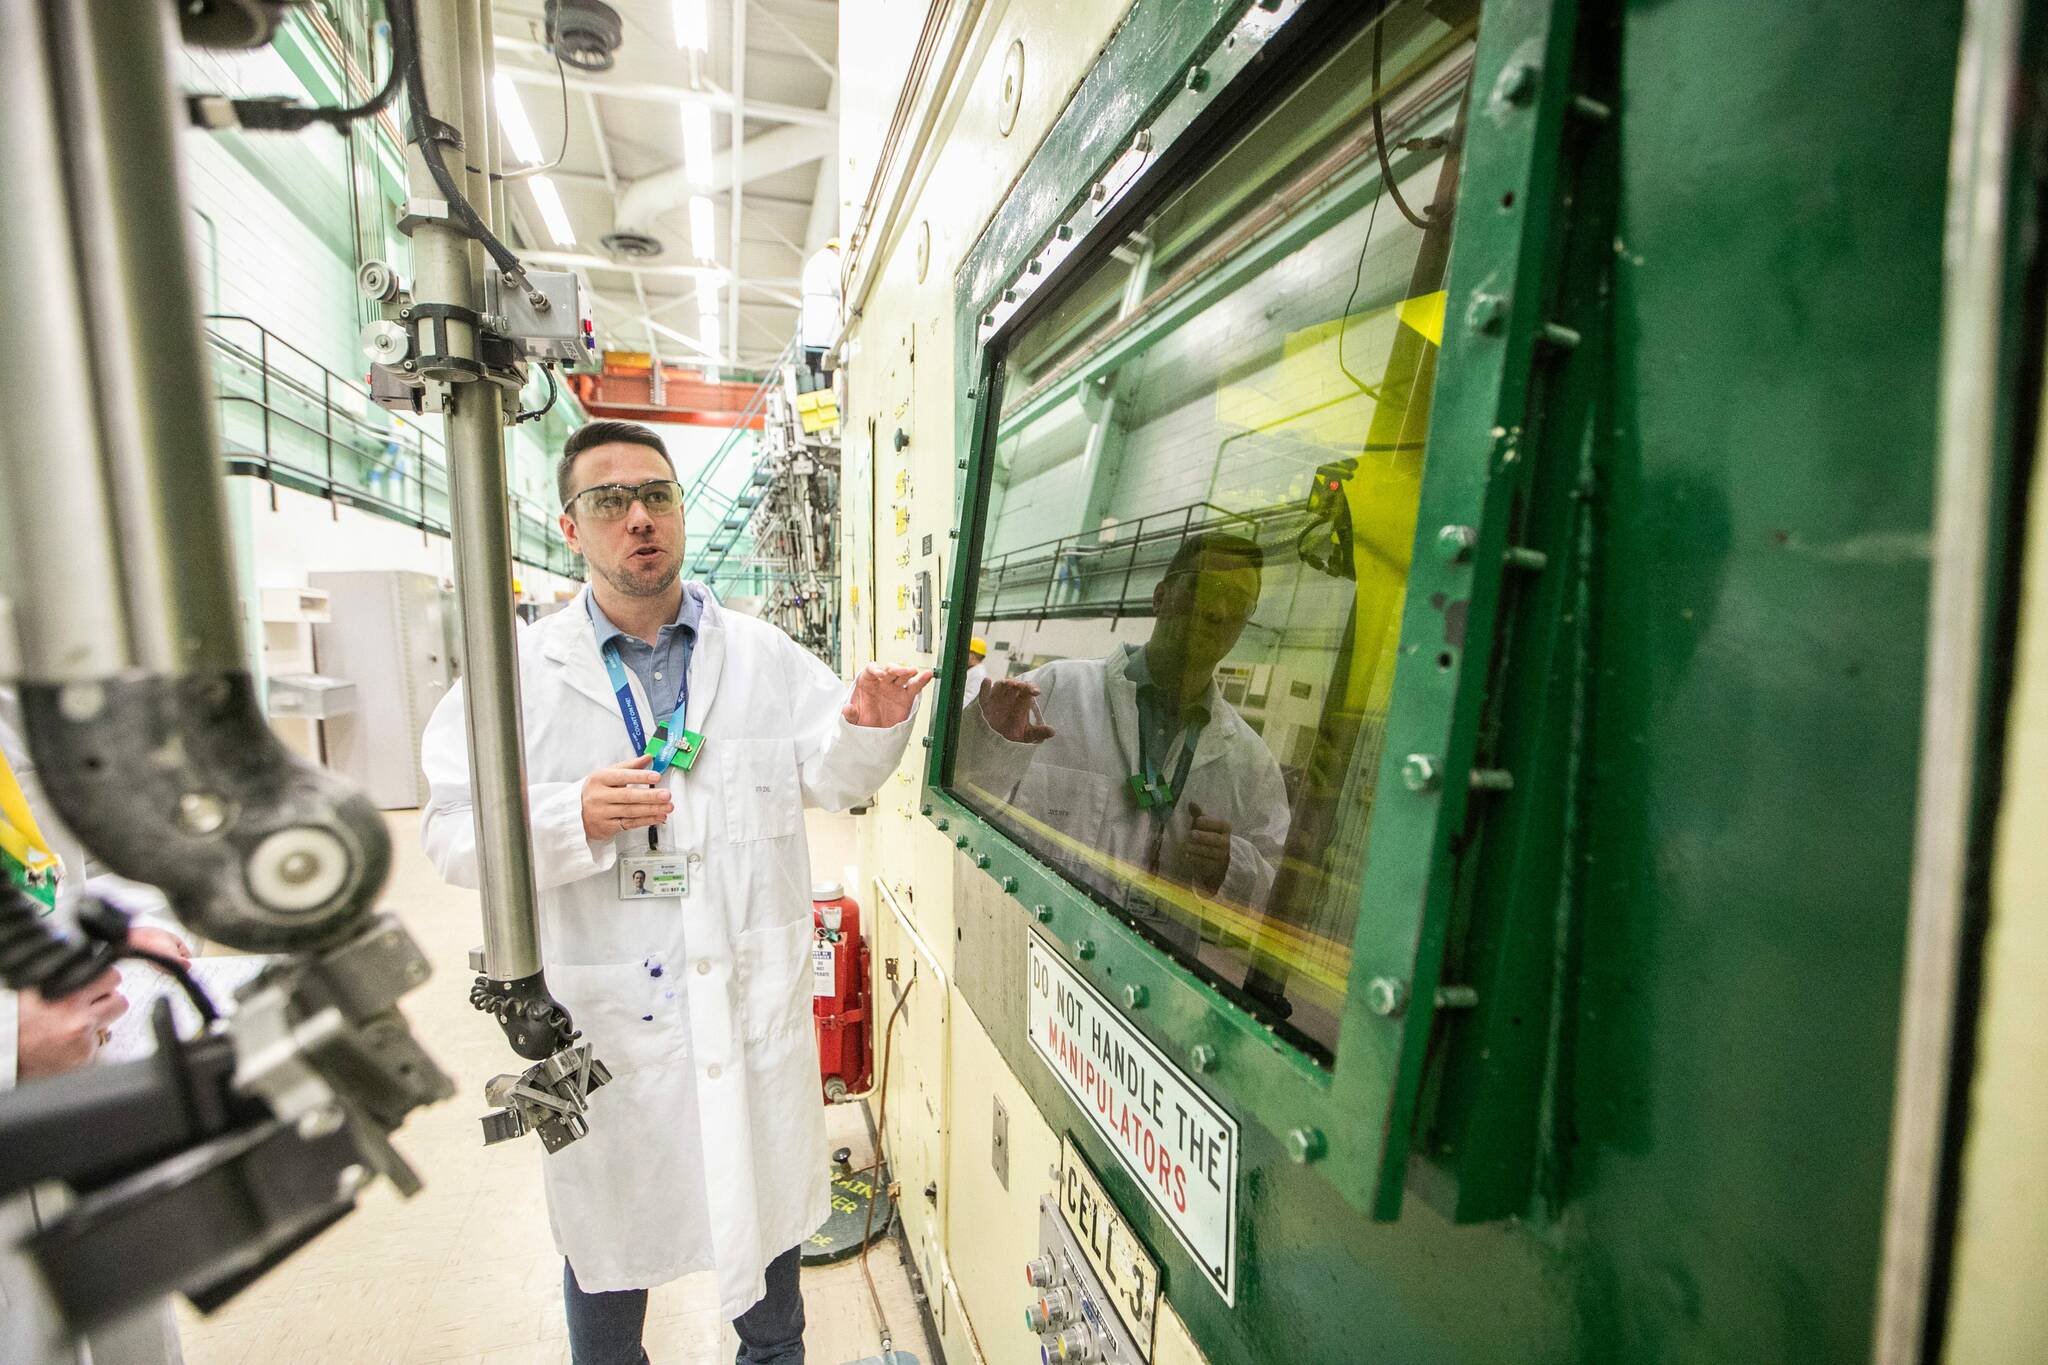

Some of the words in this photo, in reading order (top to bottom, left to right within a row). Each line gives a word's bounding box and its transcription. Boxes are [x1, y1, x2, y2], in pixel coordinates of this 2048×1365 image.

[631, 716, 641, 736] COUNT
[1034, 956, 1049, 998] DO
[1057, 980, 1083, 1037] NOT
[1092, 1016, 1163, 1129] HANDLE
[1176, 1102, 1221, 1192] THE
[1049, 1016, 1186, 1213] MANIPULATORS
[1068, 1167, 1117, 1285] CELL
